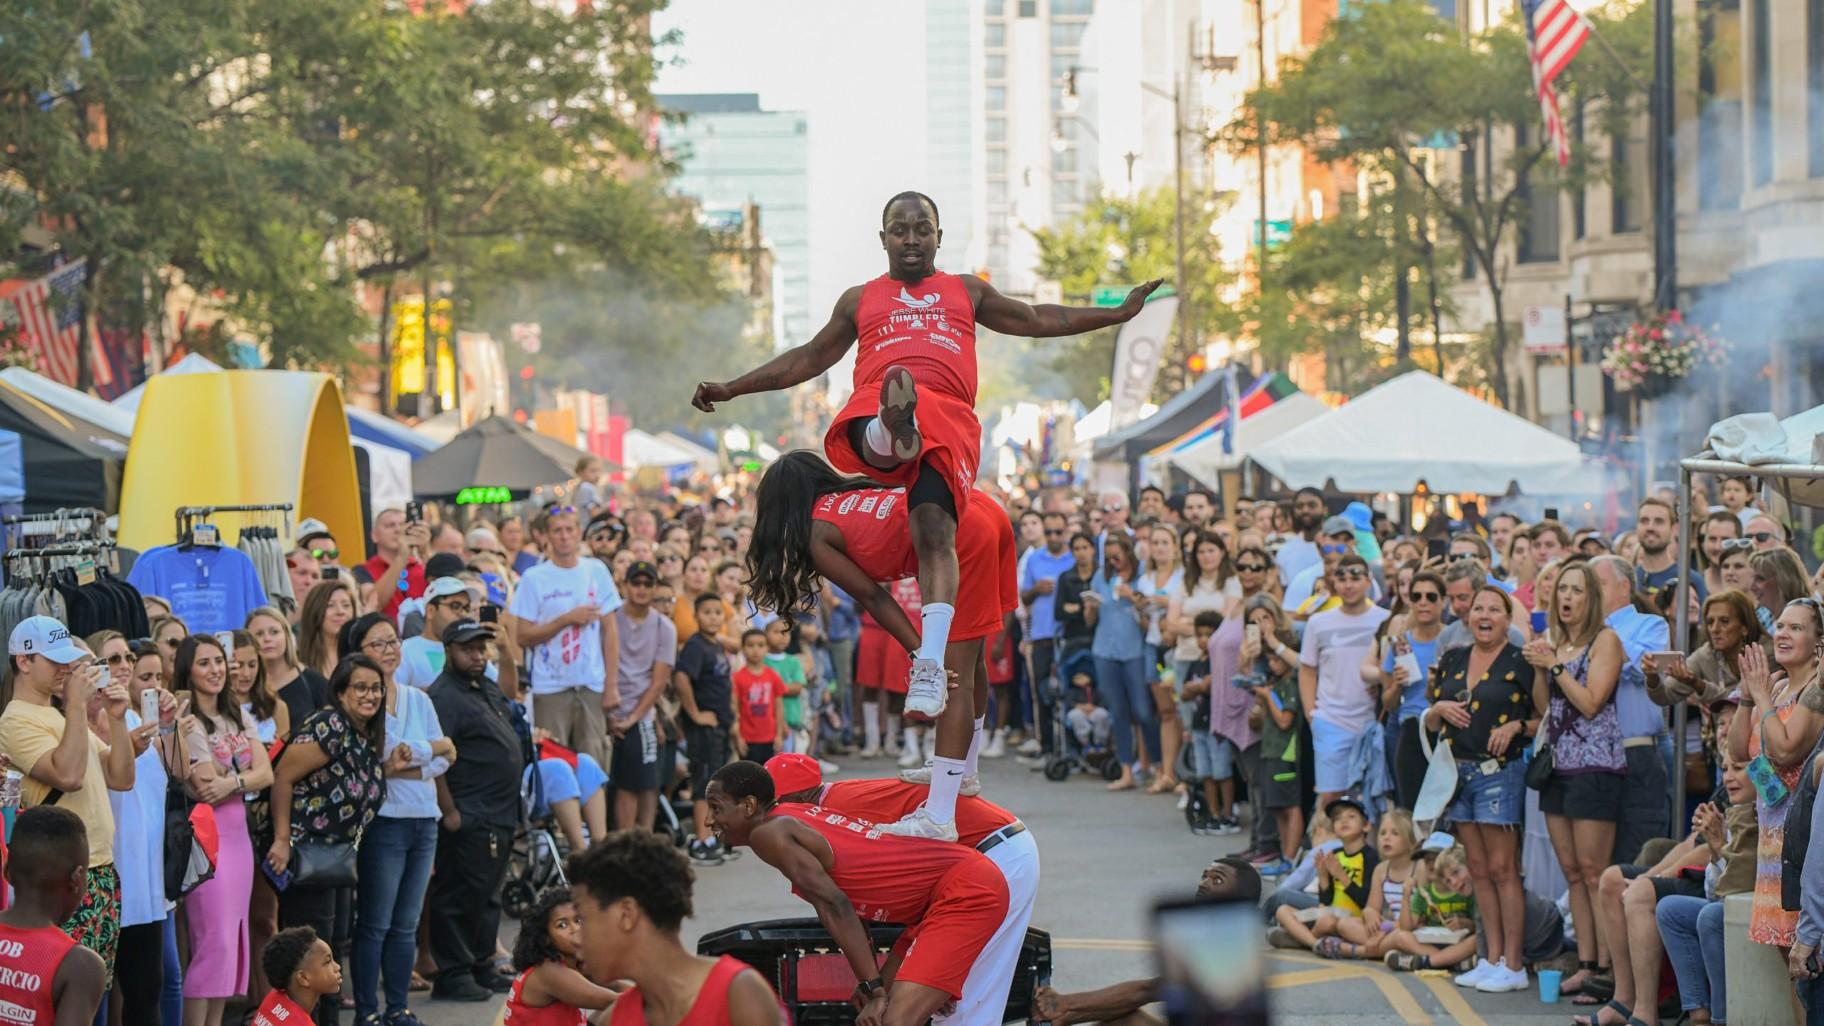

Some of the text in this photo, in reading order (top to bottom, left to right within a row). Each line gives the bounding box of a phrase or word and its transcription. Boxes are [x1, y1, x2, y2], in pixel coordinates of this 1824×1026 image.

[889, 307, 945, 316] JESSE WHITE
[456, 487, 511, 505] ATM
[272, 1003, 290, 1021] BOB
